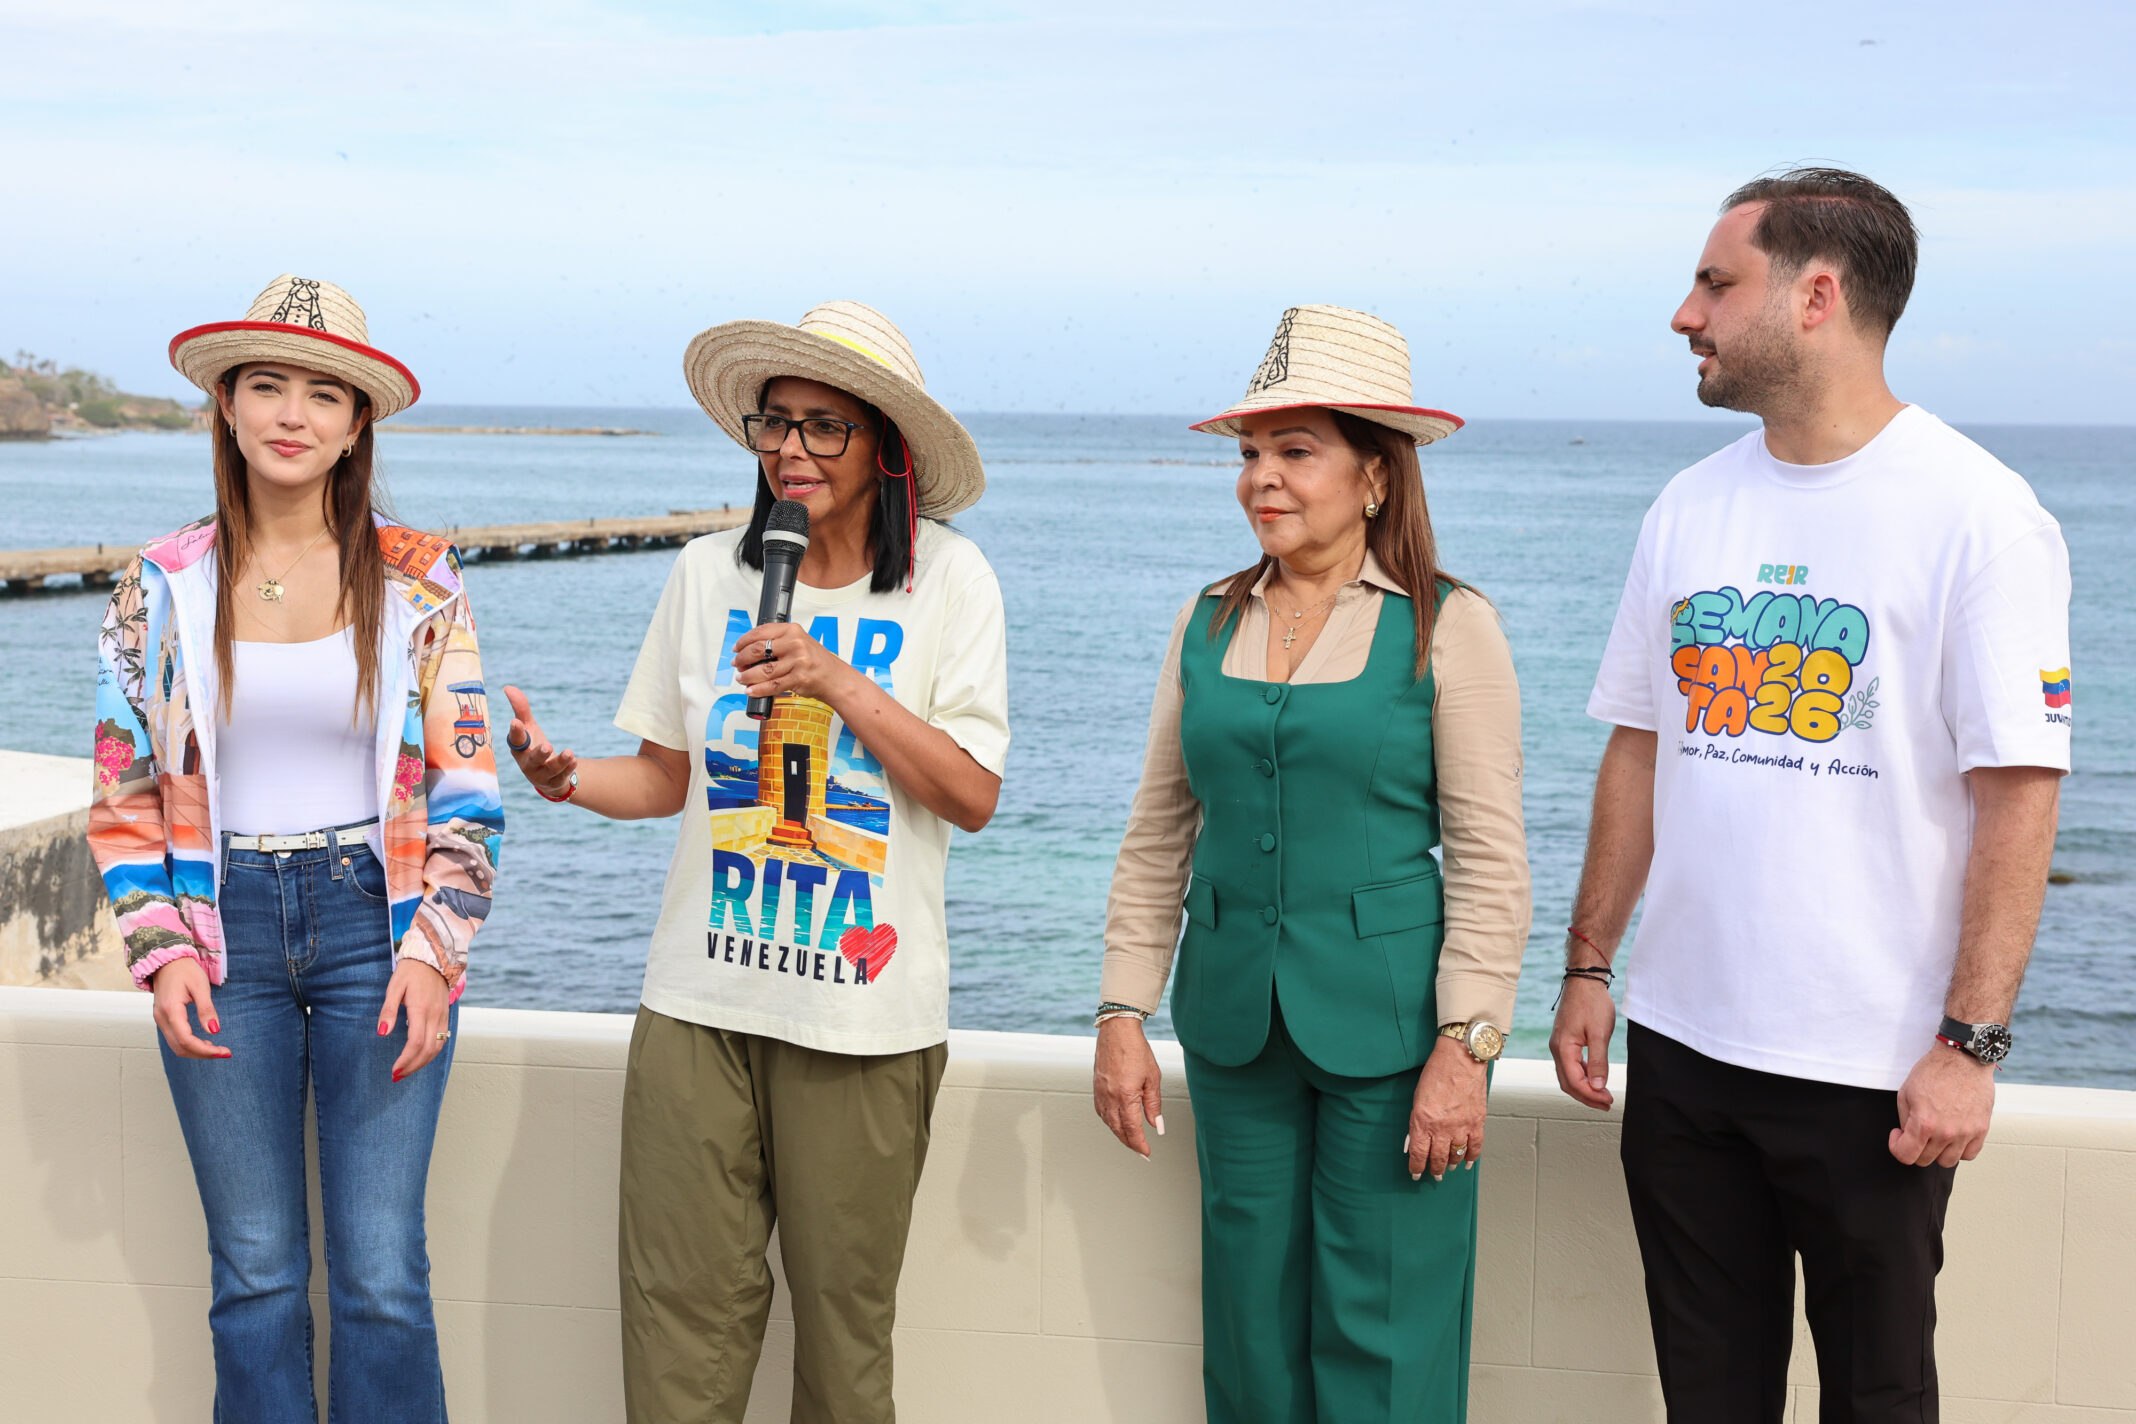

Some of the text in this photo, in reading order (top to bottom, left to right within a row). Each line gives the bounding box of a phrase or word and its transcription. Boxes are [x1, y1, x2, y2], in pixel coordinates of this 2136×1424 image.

[1670, 586, 1869, 667] SEMANA
[1686, 682, 1750, 737] TA
[1748, 681, 1844, 743] 26
[1704, 743, 1729, 762] Paz,
[1731, 748, 1804, 771] Comunidad
[1810, 762, 1820, 777] y
[1827, 758, 1879, 780] Acción
[708, 848, 874, 952] RITA
[707, 932, 868, 985] VENEZUELA
